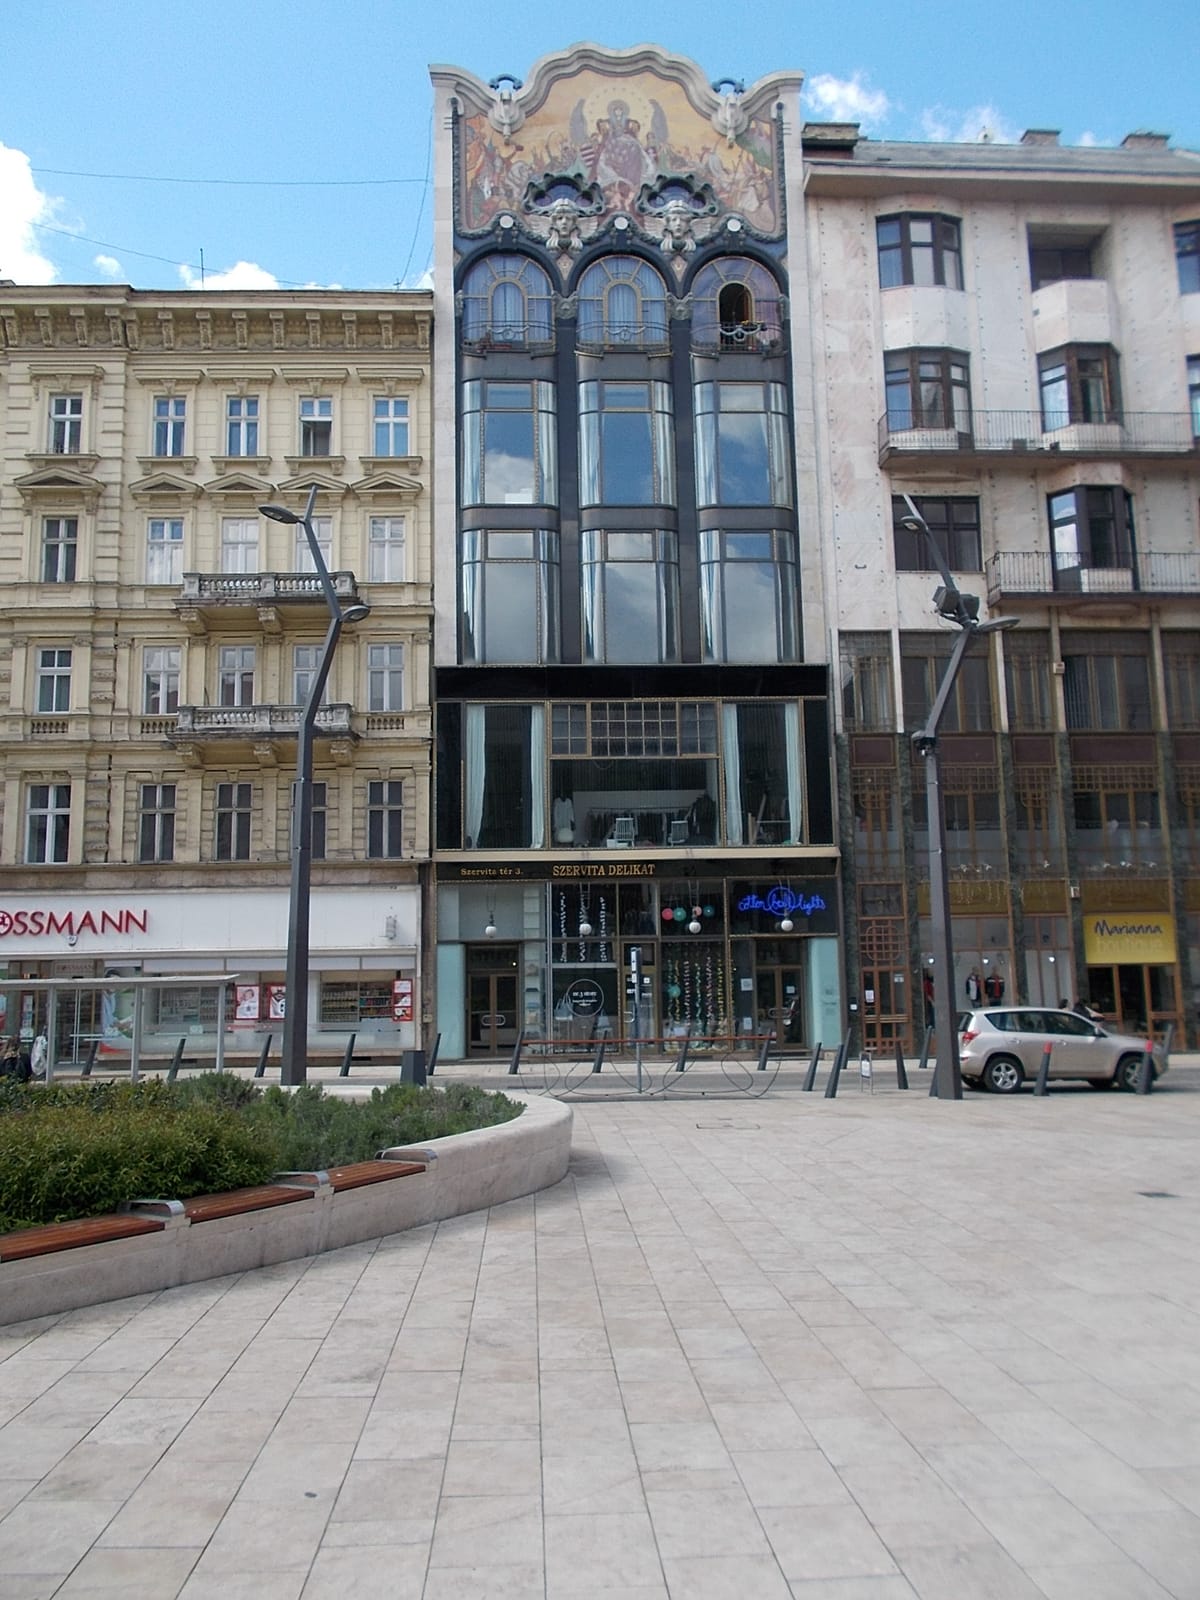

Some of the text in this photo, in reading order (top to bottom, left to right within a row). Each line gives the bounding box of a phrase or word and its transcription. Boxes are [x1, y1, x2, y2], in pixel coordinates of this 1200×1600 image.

[460, 867, 497, 876] Szervita
[499, 867, 513, 876] tér
[552, 864, 656, 877] SZERVITA DELIKAT
[1094, 919, 1163, 937] Marianna
